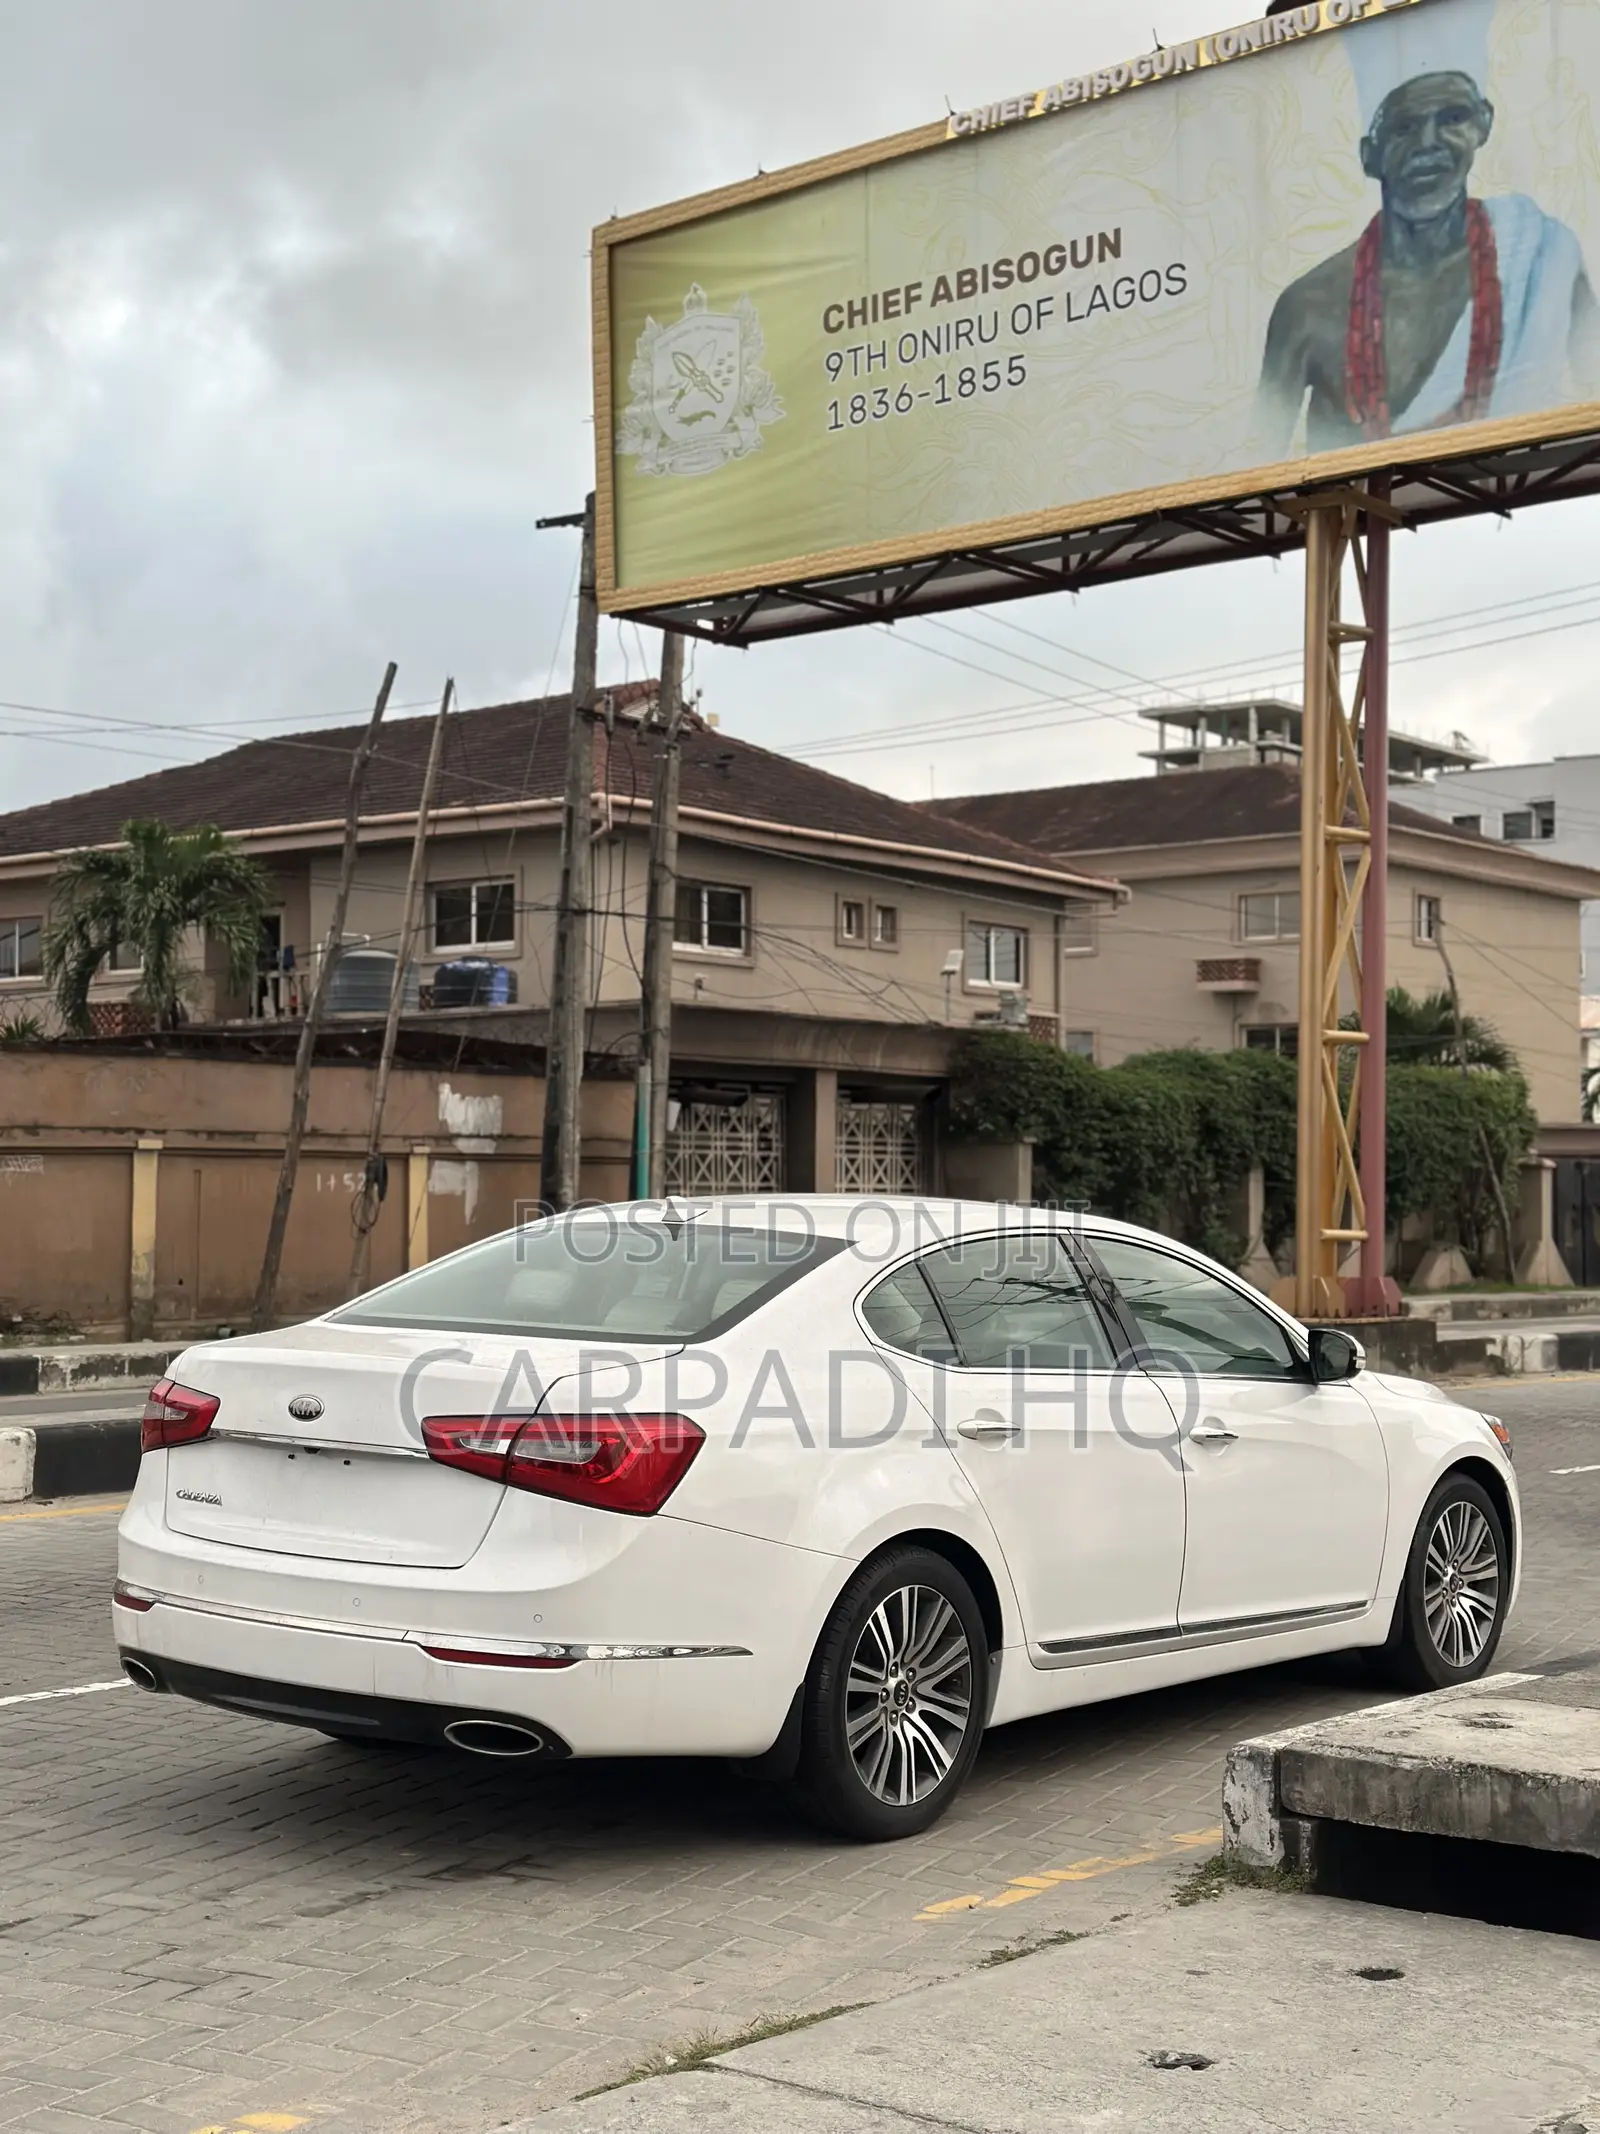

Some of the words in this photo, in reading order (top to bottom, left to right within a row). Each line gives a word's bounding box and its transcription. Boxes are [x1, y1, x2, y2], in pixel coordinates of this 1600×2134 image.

[951, 92, 1034, 134] CHIEF
[1043, 41, 1199, 111] ABISOGUN
[1206, 3, 1320, 62] (ONIRU
[823, 281, 922, 334] CHIEF
[930, 228, 1122, 308] ABISOGUN
[825, 340, 886, 382] 9TH
[899, 311, 998, 363] ONIRU
[1011, 296, 1054, 335] OF
[1066, 263, 1188, 323] LAGOS
[827, 354, 1027, 430] 1836-1855
[290, 1399, 321, 1417] KIA
